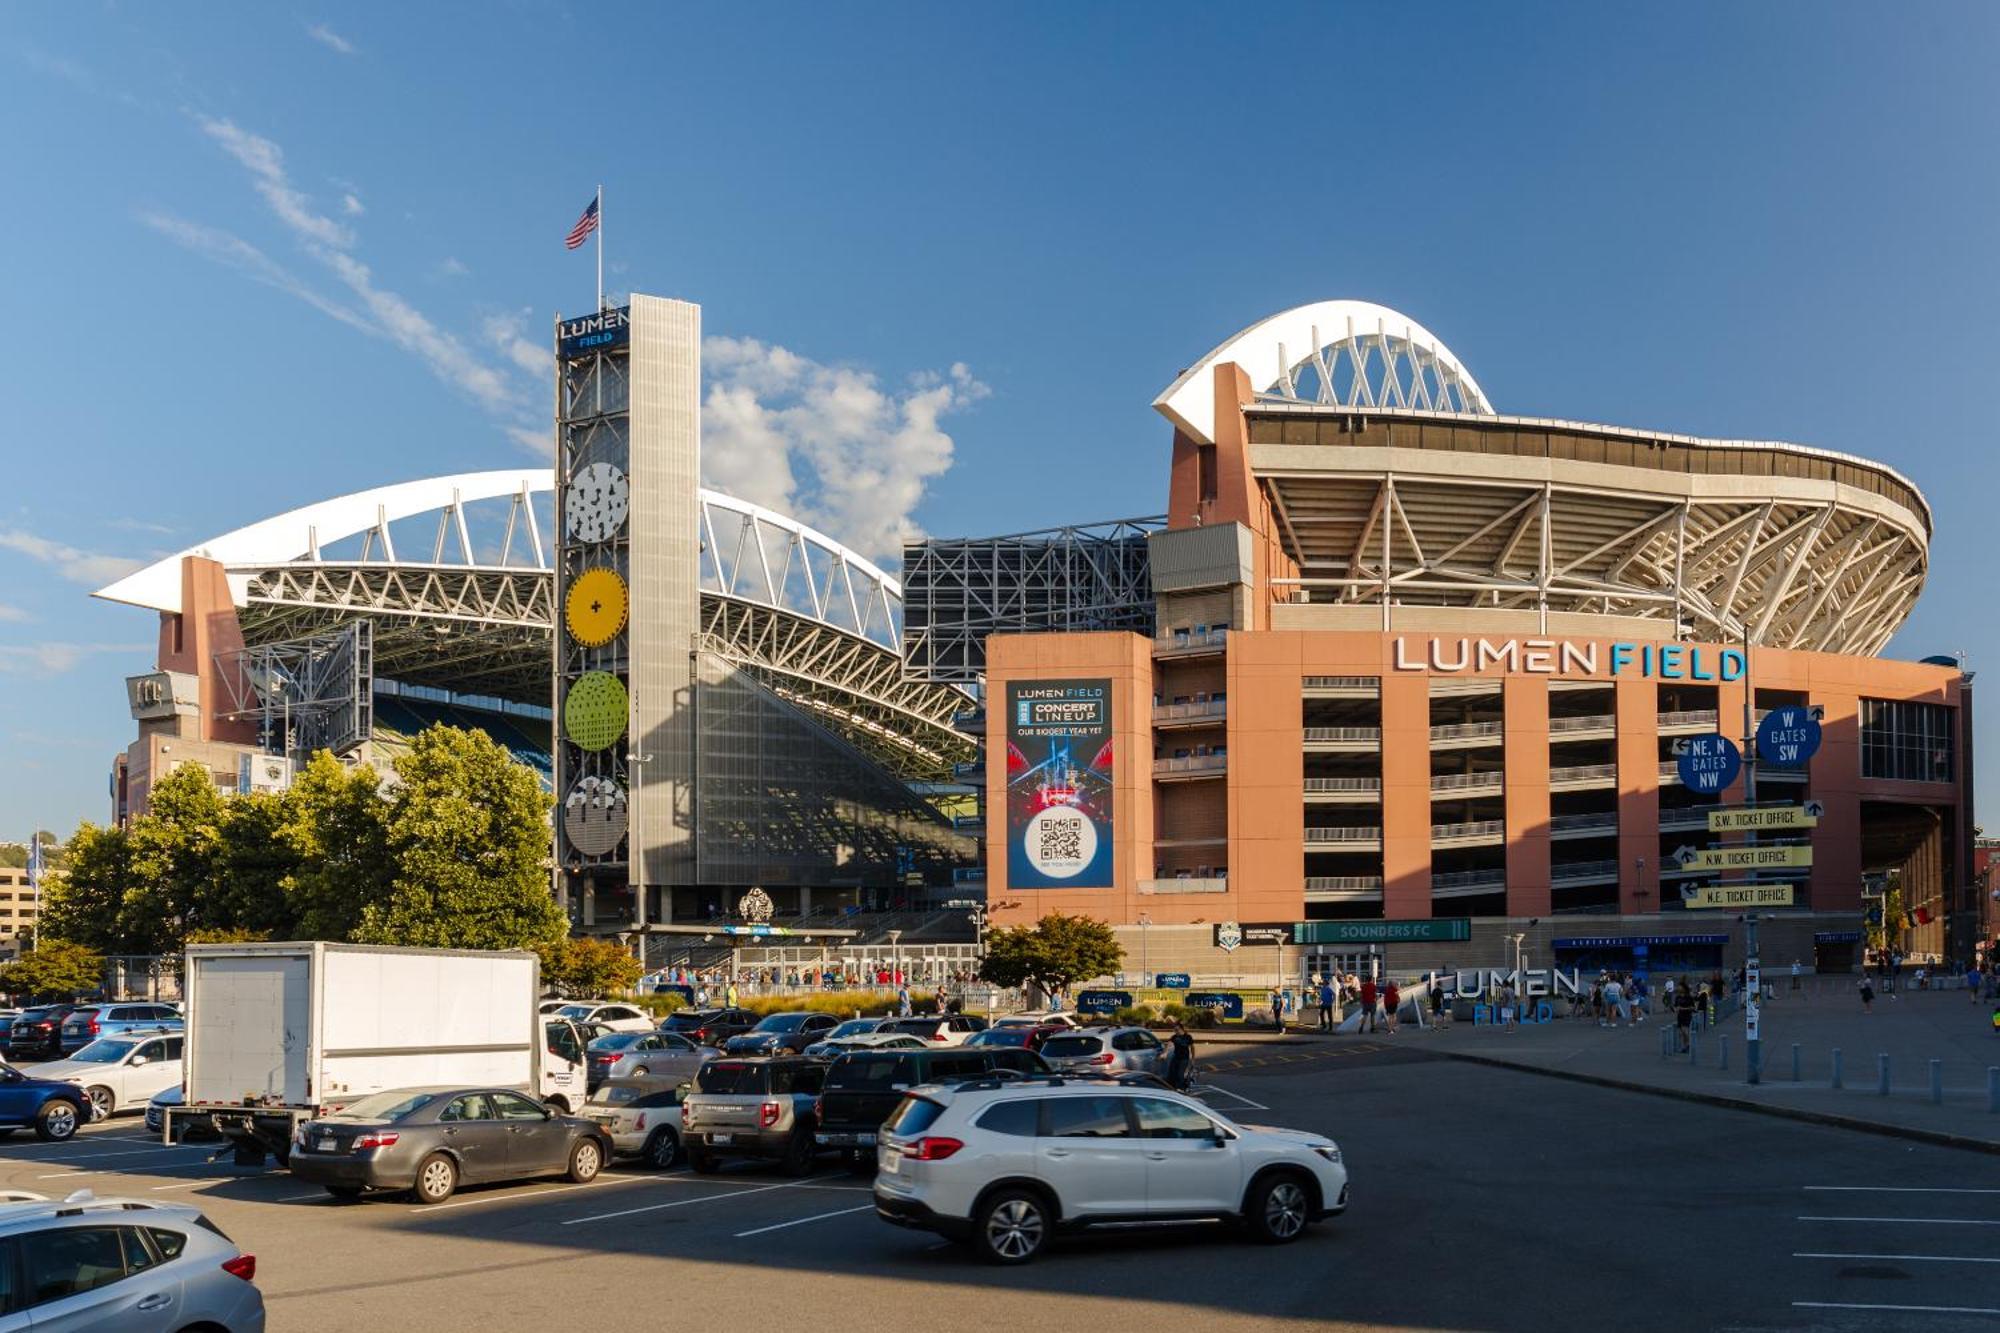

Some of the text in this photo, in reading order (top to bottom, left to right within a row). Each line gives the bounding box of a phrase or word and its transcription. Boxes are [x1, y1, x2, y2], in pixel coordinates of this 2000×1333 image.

[560, 312, 630, 339] LUMEN
[579, 332, 613, 348] FIELD
[1394, 636, 1747, 681] LUMEN FIELD
[1017, 688, 1103, 698] LUMEN FIELD
[1035, 703, 1096, 712] CONCERT
[1035, 712, 1096, 722] LINEUP
[1782, 711, 1795, 728] W
[1018, 728, 1034, 736] OUR
[1068, 727, 1087, 735] YEAR
[1089, 726, 1102, 734] YET
[1771, 728, 1807, 744] GATES
[1717, 739, 1725, 755] N
[1779, 744, 1799, 762] SW
[1692, 756, 1727, 772] GATES
[1699, 772, 1719, 788] NW
[1715, 811, 1795, 828] S.W. TICKET OFFICE
[1706, 850, 1787, 866] N.W. TICKET OFFICE
[1707, 888, 1786, 903] N.E. TICKET OFFICE
[1340, 925, 1431, 938] SOUNDERS FC
[1087, 998, 1123, 1006] LUMEN
